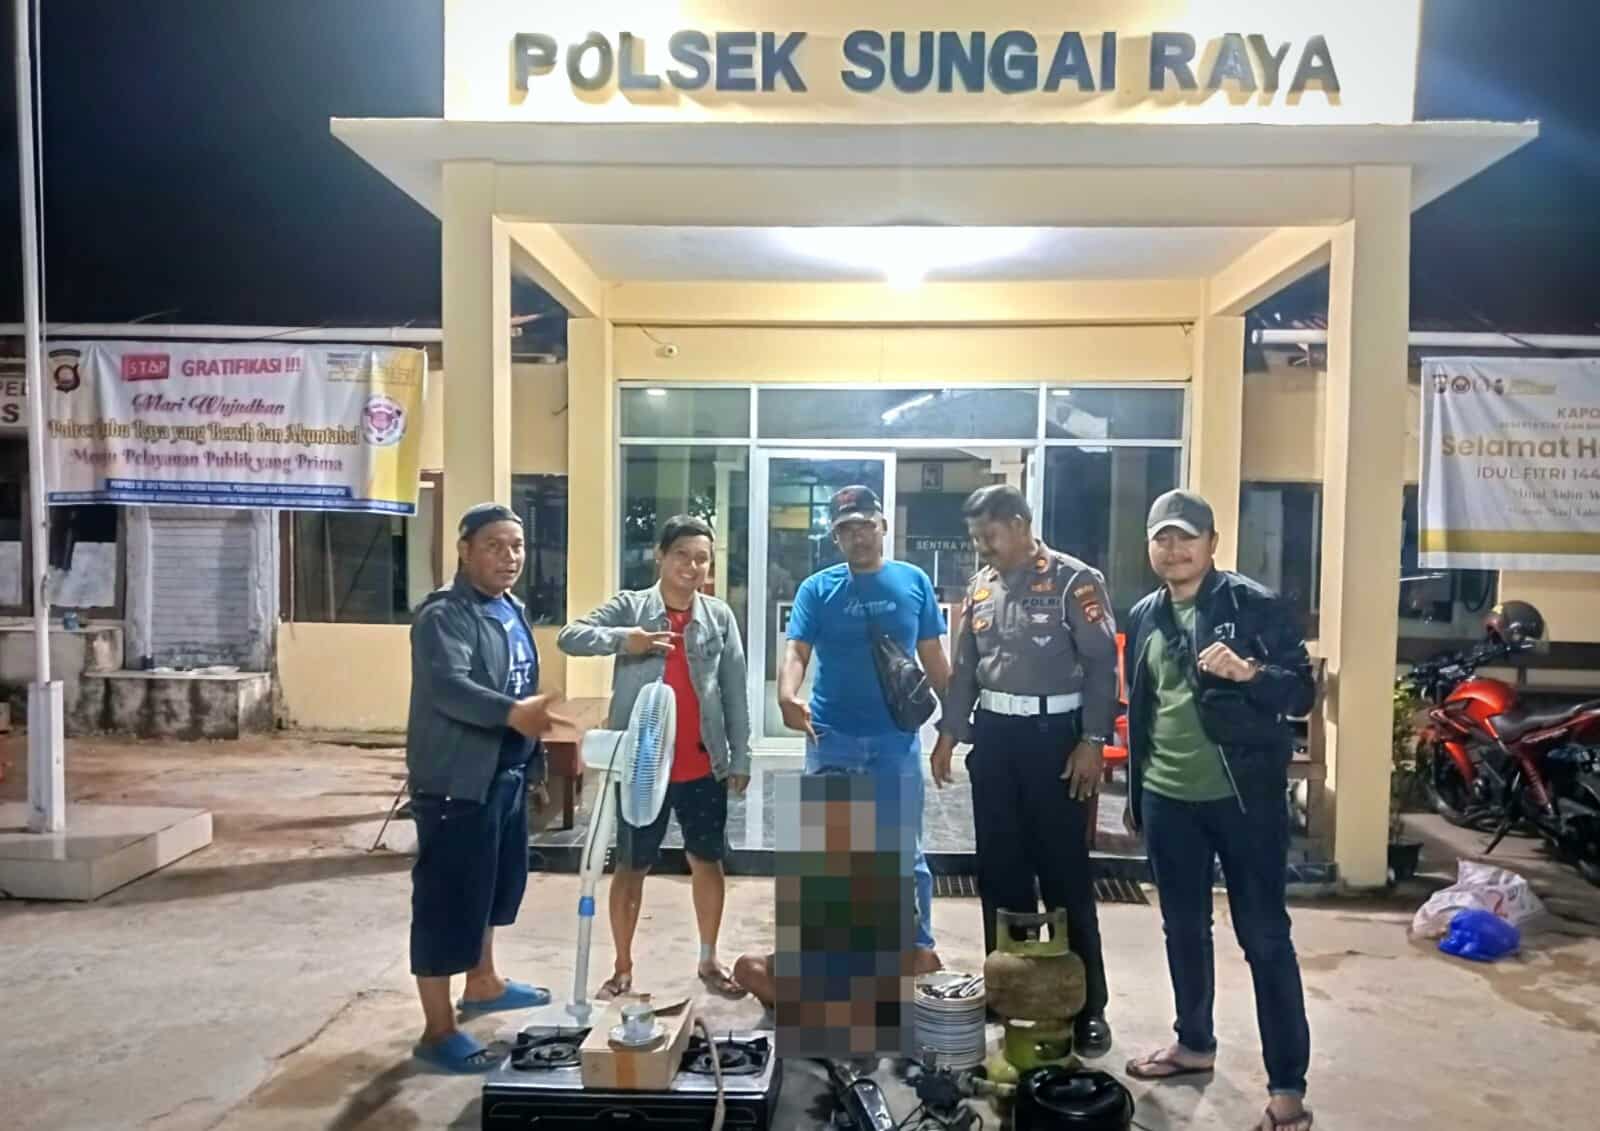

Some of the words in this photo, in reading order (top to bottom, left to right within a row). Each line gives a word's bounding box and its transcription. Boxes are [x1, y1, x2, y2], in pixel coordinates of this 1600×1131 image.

[515, 30, 807, 92] POLSEK
[840, 29, 1117, 94] SUNGAI
[1149, 31, 1341, 92] RAYA
[182, 357, 282, 377] GRATIFIKASI
[285, 356, 302, 373] !!!
[132, 393, 186, 413] Mari
[188, 395, 286, 417] Wujudkan
[170, 424, 206, 444] yang
[256, 422, 282, 443] dan
[1441, 434, 1570, 458] Selamat
[122, 449, 199, 469] Pelayanan
[202, 450, 254, 471] Publik
[254, 456, 291, 473] yang
[294, 453, 343, 471] Prima
[1477, 466, 1520, 480] IDUL
[1523, 466, 1567, 480] FITRI
[916, 539, 957, 551] SENTRA
